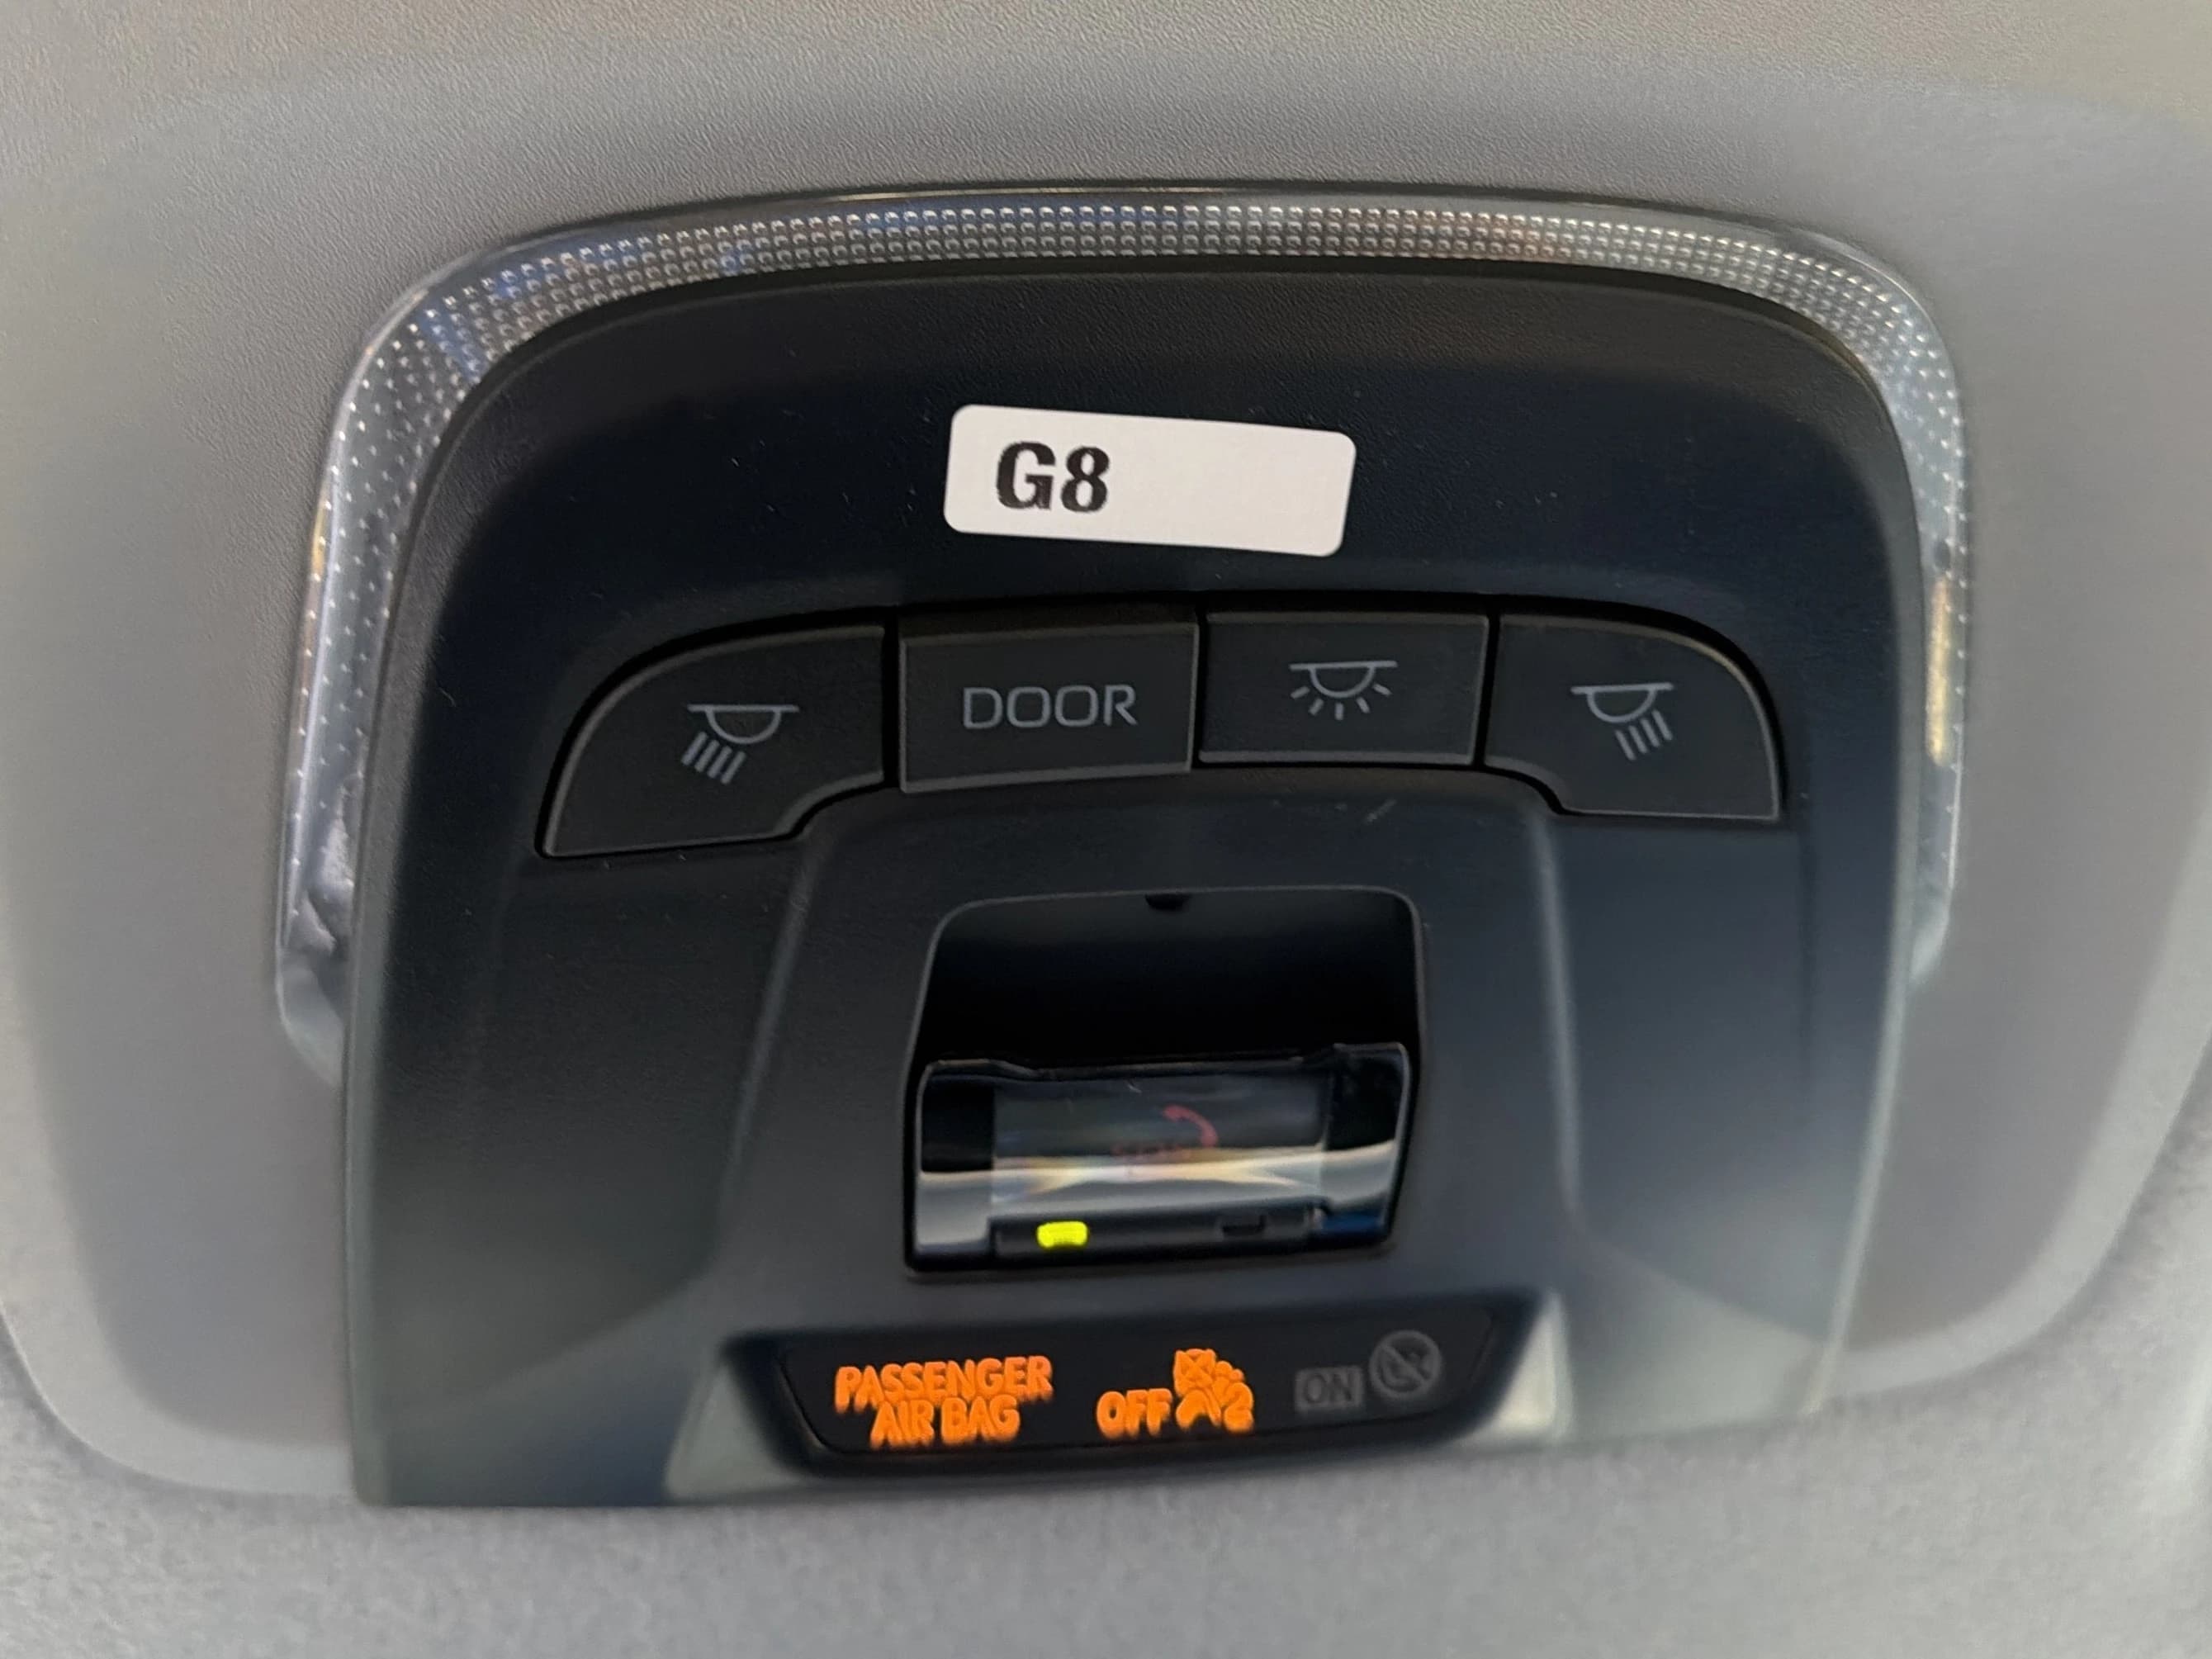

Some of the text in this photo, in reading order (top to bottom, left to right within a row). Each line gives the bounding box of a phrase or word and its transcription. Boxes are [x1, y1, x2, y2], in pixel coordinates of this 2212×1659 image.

[996, 441, 1110, 513] G8
[963, 685, 1138, 729] DOOR
[835, 1355, 1053, 1413] PASSENGER
[1300, 1370, 1354, 1405] ON
[870, 1394, 1021, 1448] AIR BAG
[1096, 1388, 1172, 1438] OFF
